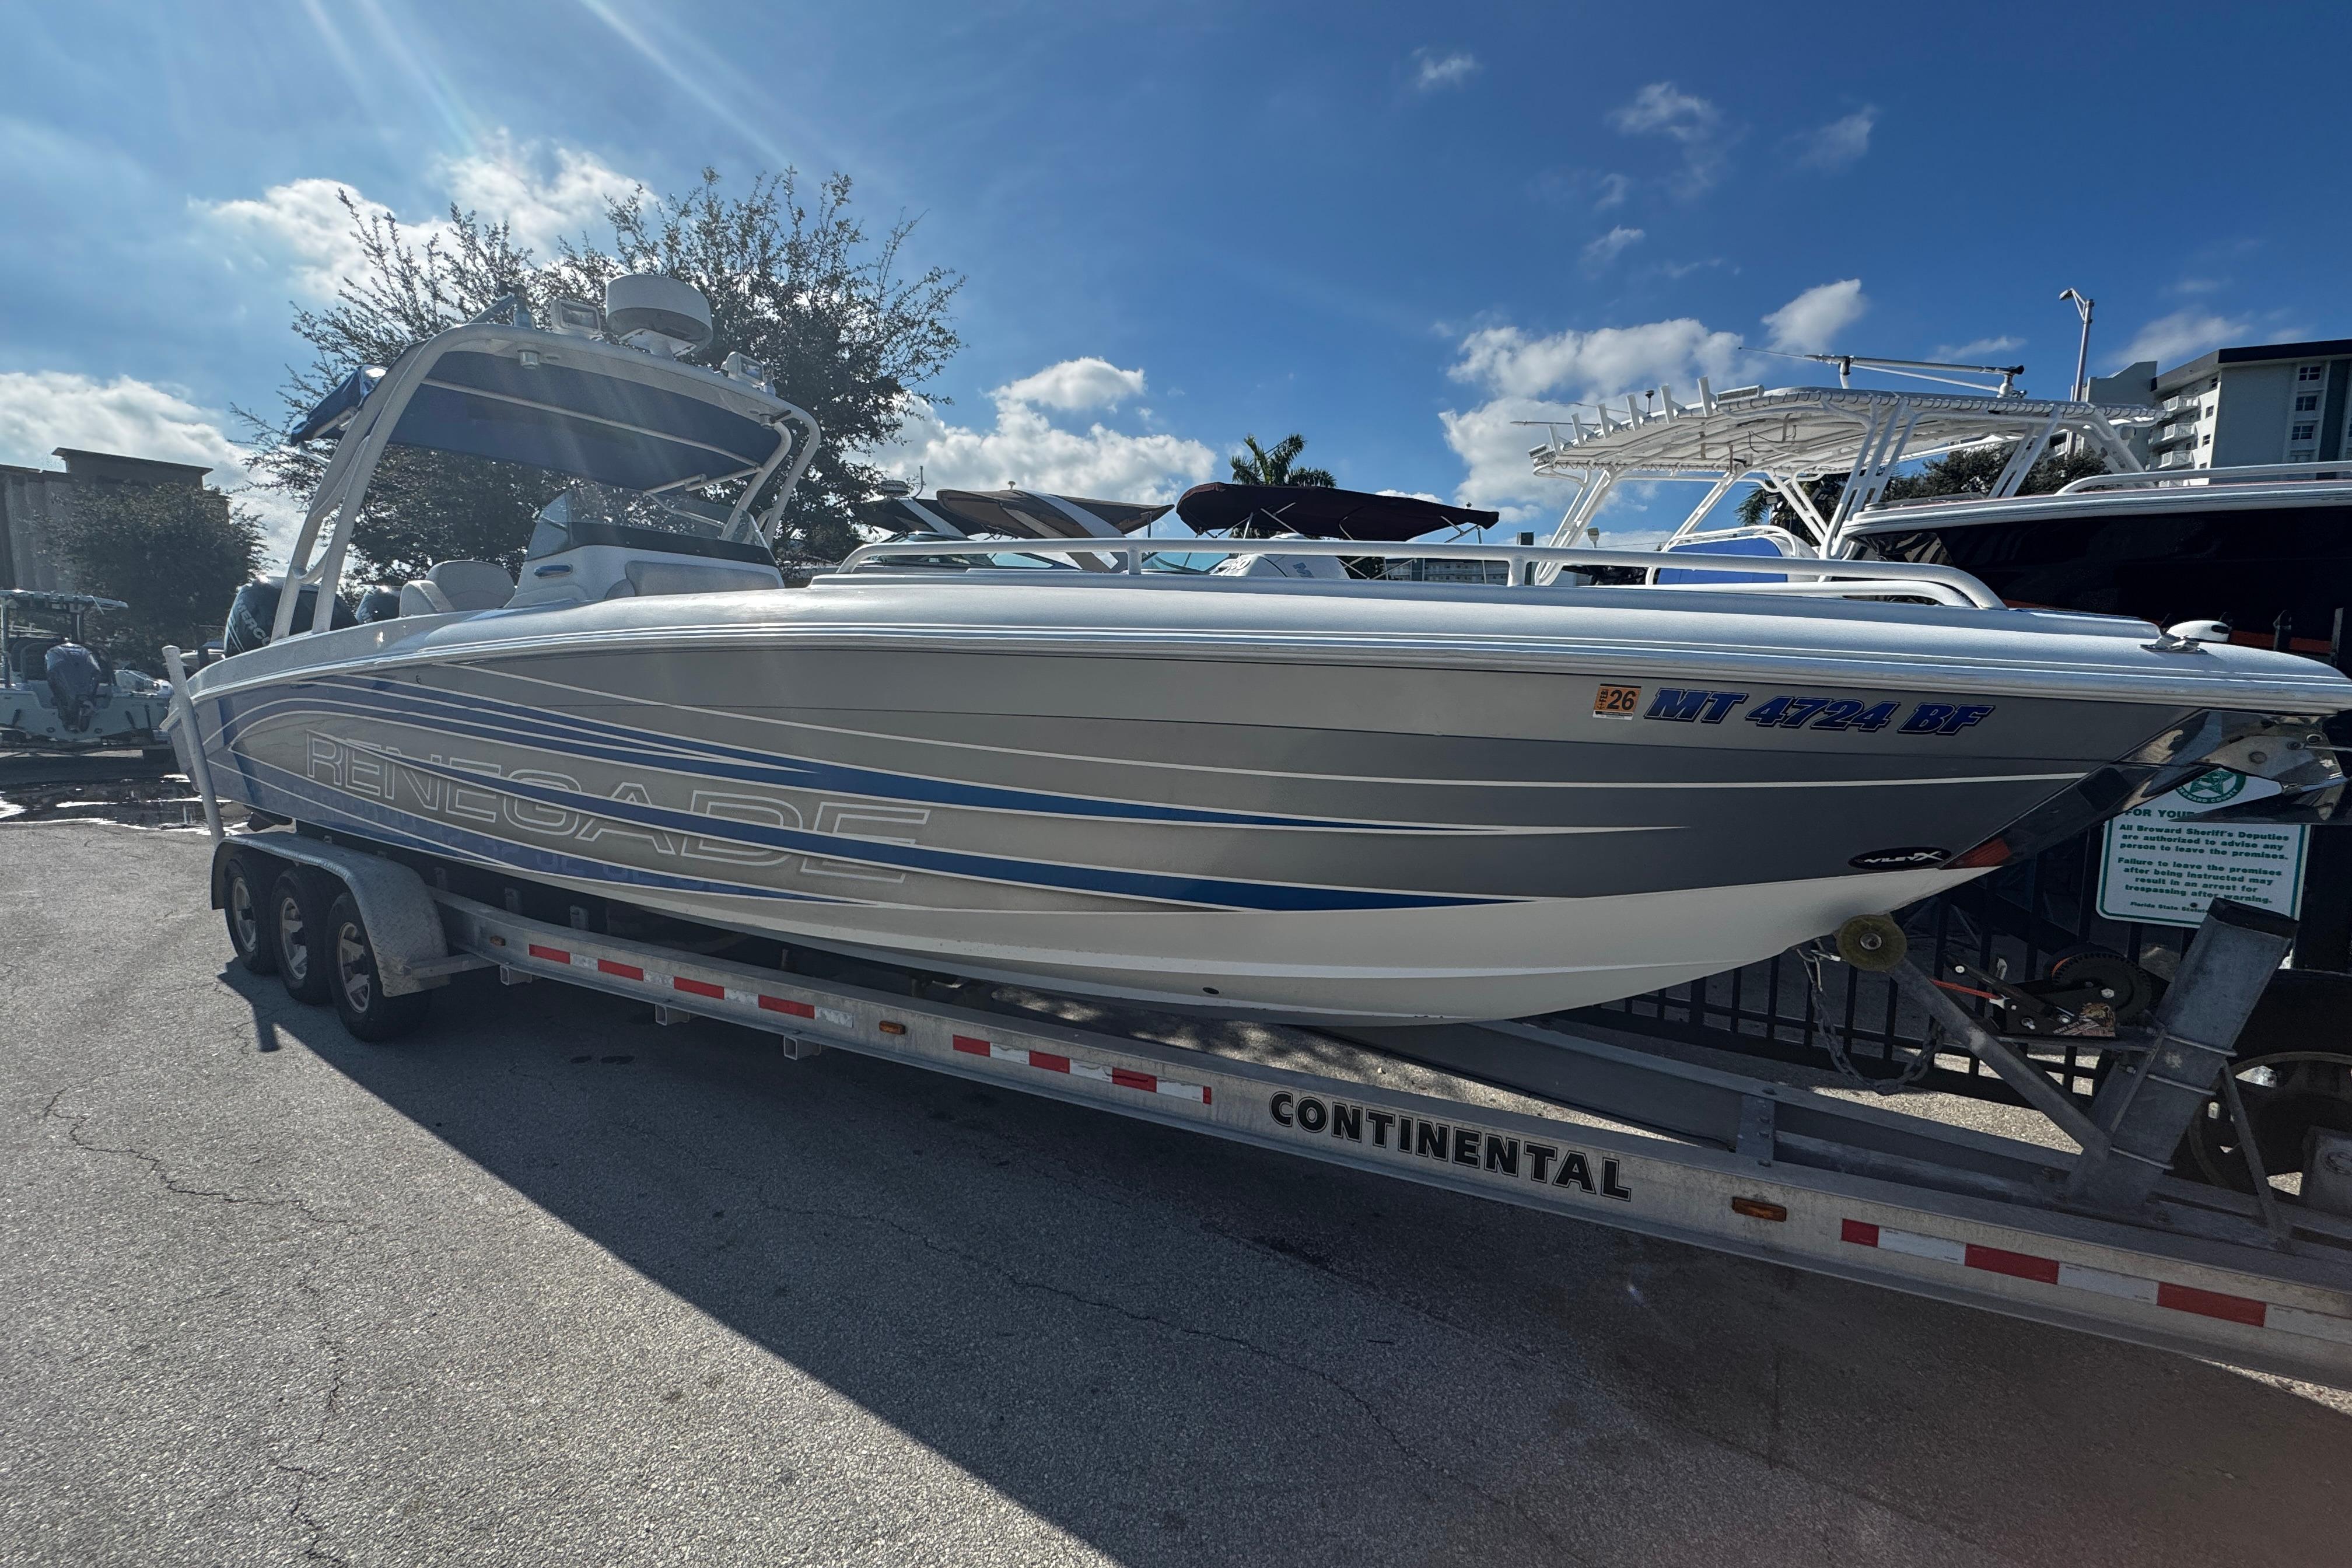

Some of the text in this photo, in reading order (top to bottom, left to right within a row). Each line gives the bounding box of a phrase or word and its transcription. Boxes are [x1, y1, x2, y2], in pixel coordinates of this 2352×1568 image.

[1599, 690, 1608, 702] FEB
[1607, 690, 1636, 710] 26
[1643, 687, 1996, 736] MT 4724 BF
[2211, 789, 2238, 803] COUNTY
[306, 729, 931, 884] RENEGADE
[2137, 825, 2182, 834] Broward
[2186, 828, 2234, 838] Sheriff's
[2238, 831, 2289, 841] Deputies
[2143, 835, 2200, 845] authorized
[2221, 840, 2258, 848] advise
[2263, 843, 2284, 851] any
[2120, 842, 2156, 850] person
[2175, 845, 2205, 853] leave
[2232, 850, 2288, 860] premises.
[2118, 857, 2154, 866] Failure
[2173, 861, 2202, 870] leave
[2230, 866, 2282, 877] premises
[2123, 866, 2273, 886] after being instructed may
[2135, 876, 2166, 885] result
[2202, 883, 2236, 891] arrest
[2125, 884, 2273, 904] trespassing after warning.
[1269, 1091, 1632, 1202] CONTINENTAL
